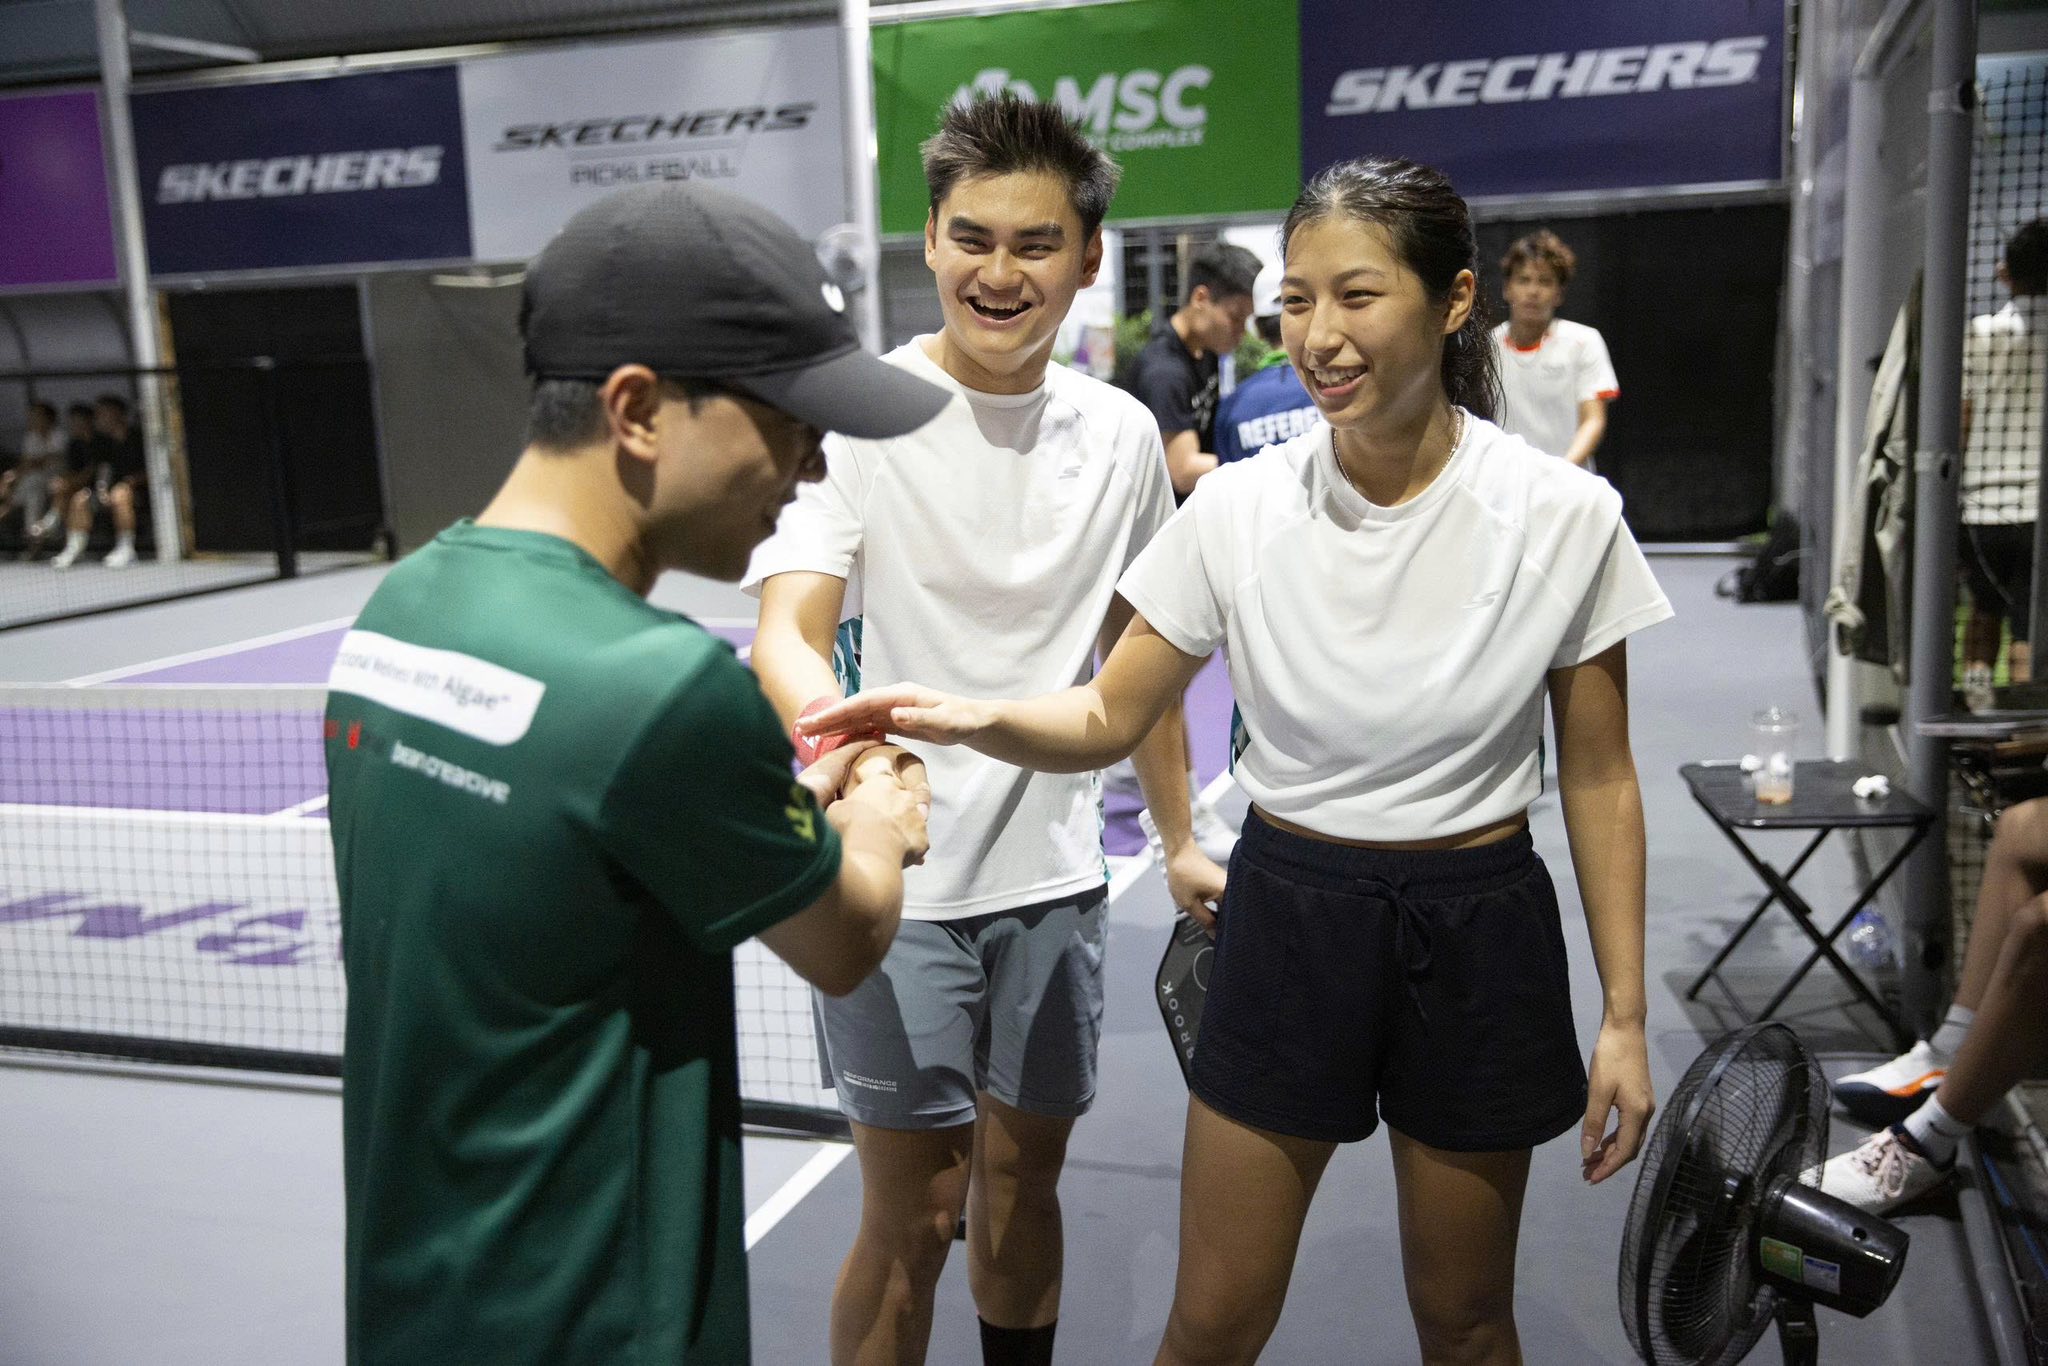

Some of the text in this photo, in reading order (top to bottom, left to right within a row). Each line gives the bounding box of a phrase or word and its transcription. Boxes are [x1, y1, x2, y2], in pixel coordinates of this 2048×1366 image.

[1052, 65, 1214, 132] MSC
[1325, 36, 1769, 117] SKECHERS
[493, 102, 817, 153] SKECHERS
[157, 146, 444, 205] SKECHERS
